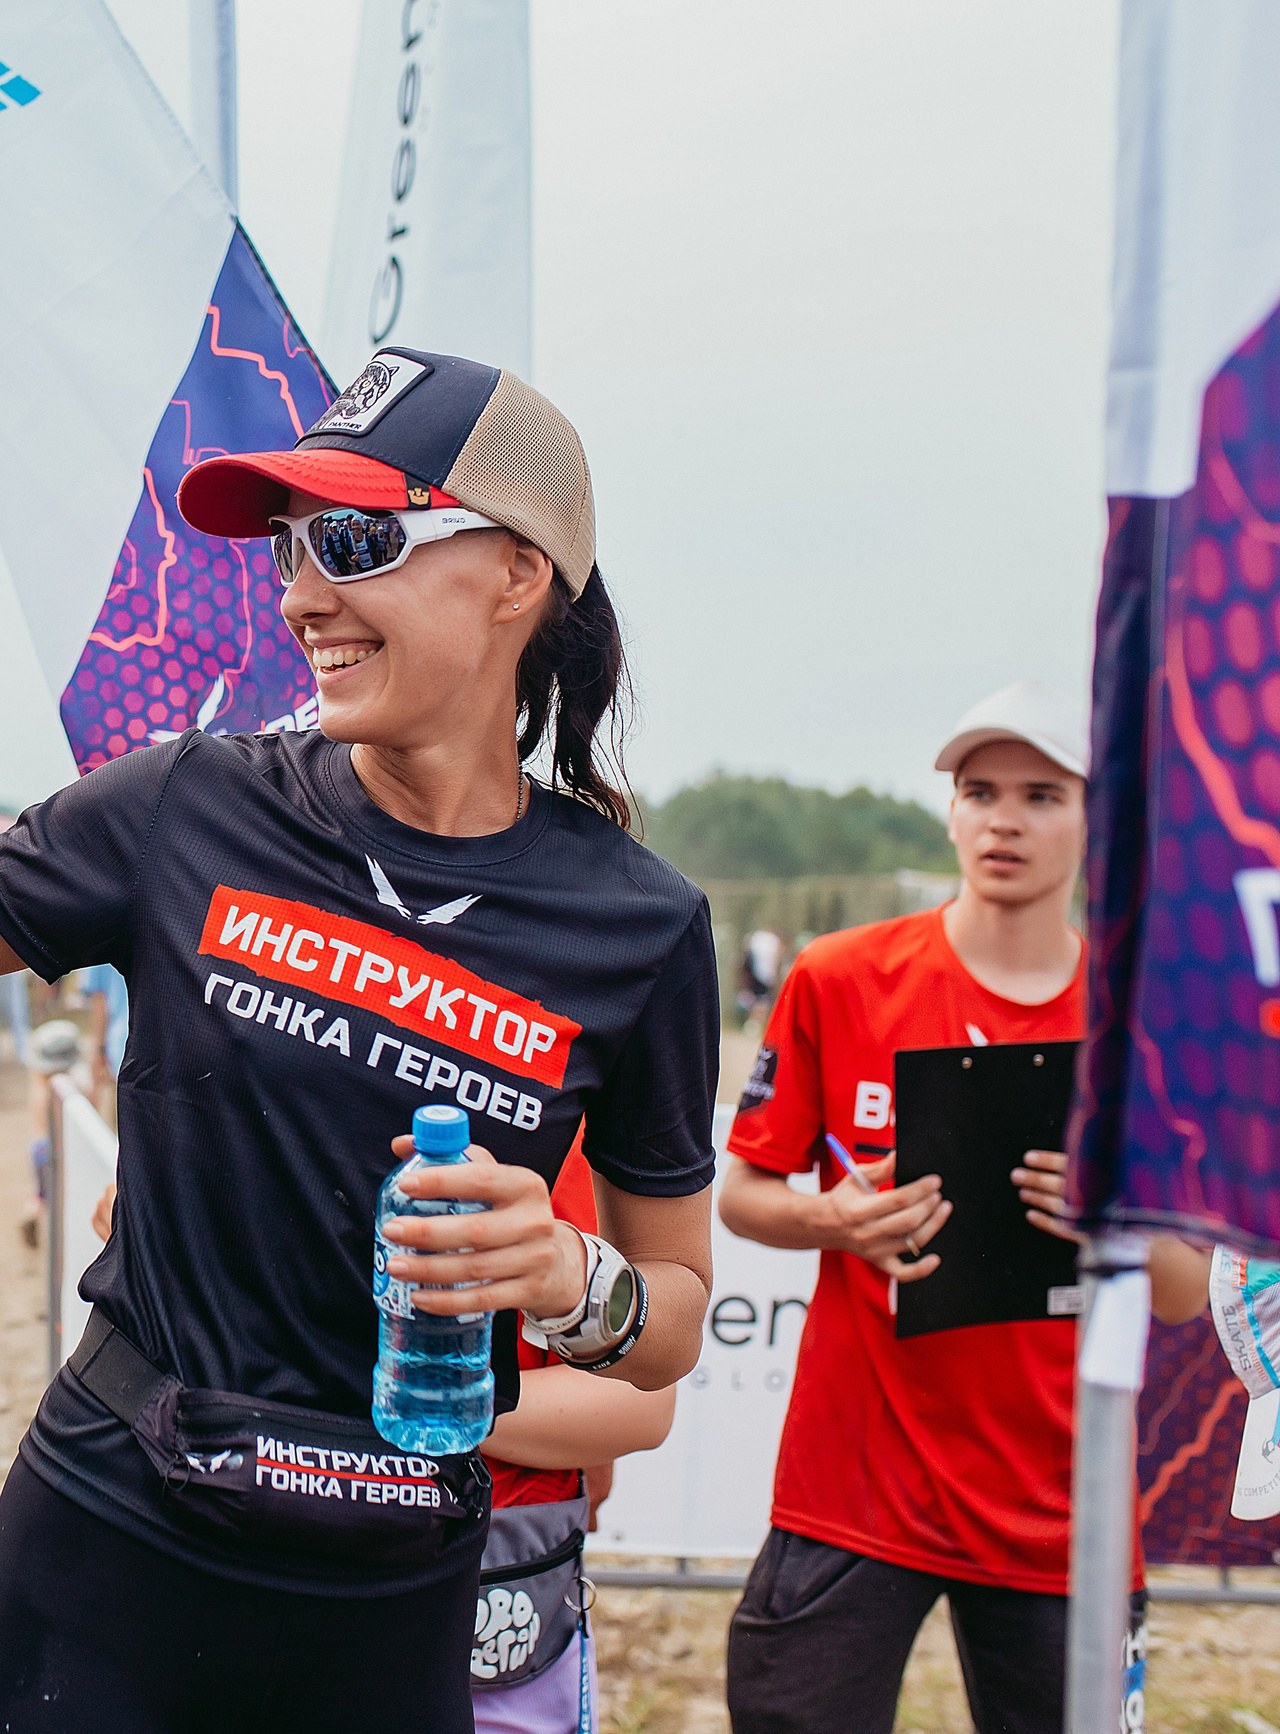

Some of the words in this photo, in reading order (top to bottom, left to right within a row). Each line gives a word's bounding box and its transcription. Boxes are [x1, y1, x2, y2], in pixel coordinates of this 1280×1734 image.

[328, 422, 362, 430] PANTHER
[218, 904, 557, 1064] ИНСТРУКТОР
[204, 972, 352, 1058] ГОНКА
[366, 1031, 544, 1133] ГЕРОЕВ
[1222, 1304, 1252, 1371] SKATE
[255, 1434, 440, 1479] ИНСТРУКТОР
[255, 1463, 343, 1499] ГОНКА
[350, 1479, 441, 1509] ГЕРОЕВ
